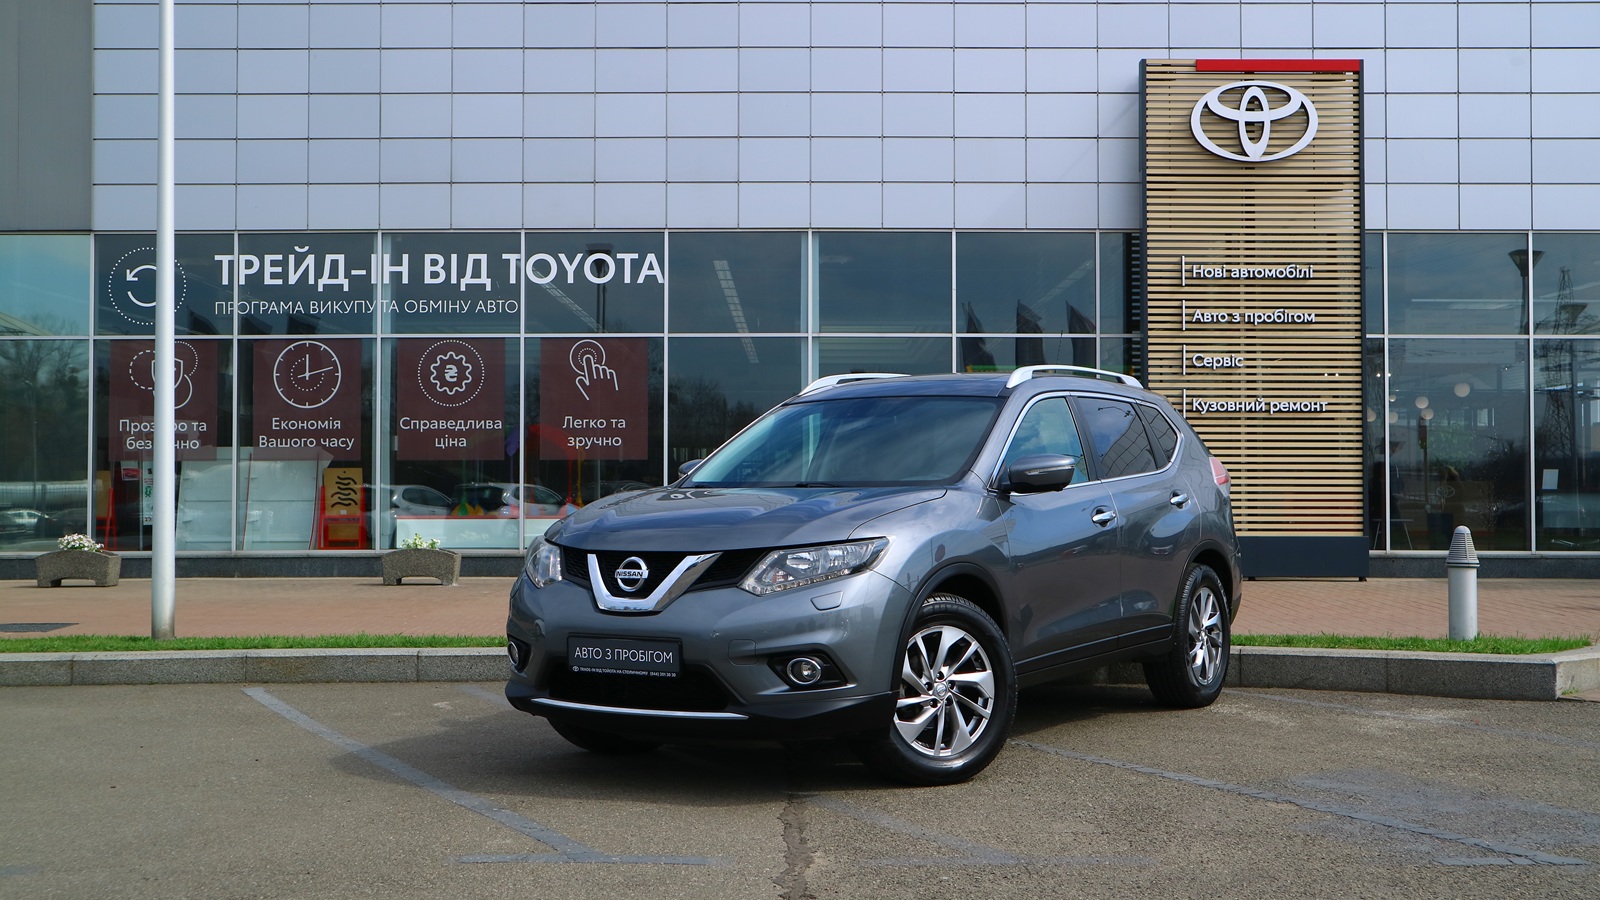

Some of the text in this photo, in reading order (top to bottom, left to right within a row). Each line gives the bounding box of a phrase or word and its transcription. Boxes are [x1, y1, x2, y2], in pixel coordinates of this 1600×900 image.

[214, 245, 664, 292] ТРЕЙД-ІН ВІД TOYOTA
[1192, 264, 1314, 279] Нові автомобілі
[215, 299, 519, 315] ПРОГРАМА ВИКУПУ ТА ОБМІНУ АВТО
[1192, 308, 1316, 326] Авто з пробігом
[1192, 354, 1244, 370] Сервіс
[1192, 397, 1328, 415] Кузовний ремонт
[119, 419, 207, 434] Прозо та
[271, 417, 341, 430] Економія
[400, 416, 502, 433] Справедлива
[562, 415, 626, 431] Легко та
[126, 437, 200, 450] безчно
[259, 435, 355, 451] Вашого часу
[435, 434, 467, 449] ціна
[567, 436, 622, 450] зручно
[574, 647, 673, 664] АВТО З ПРОБІГОМ
